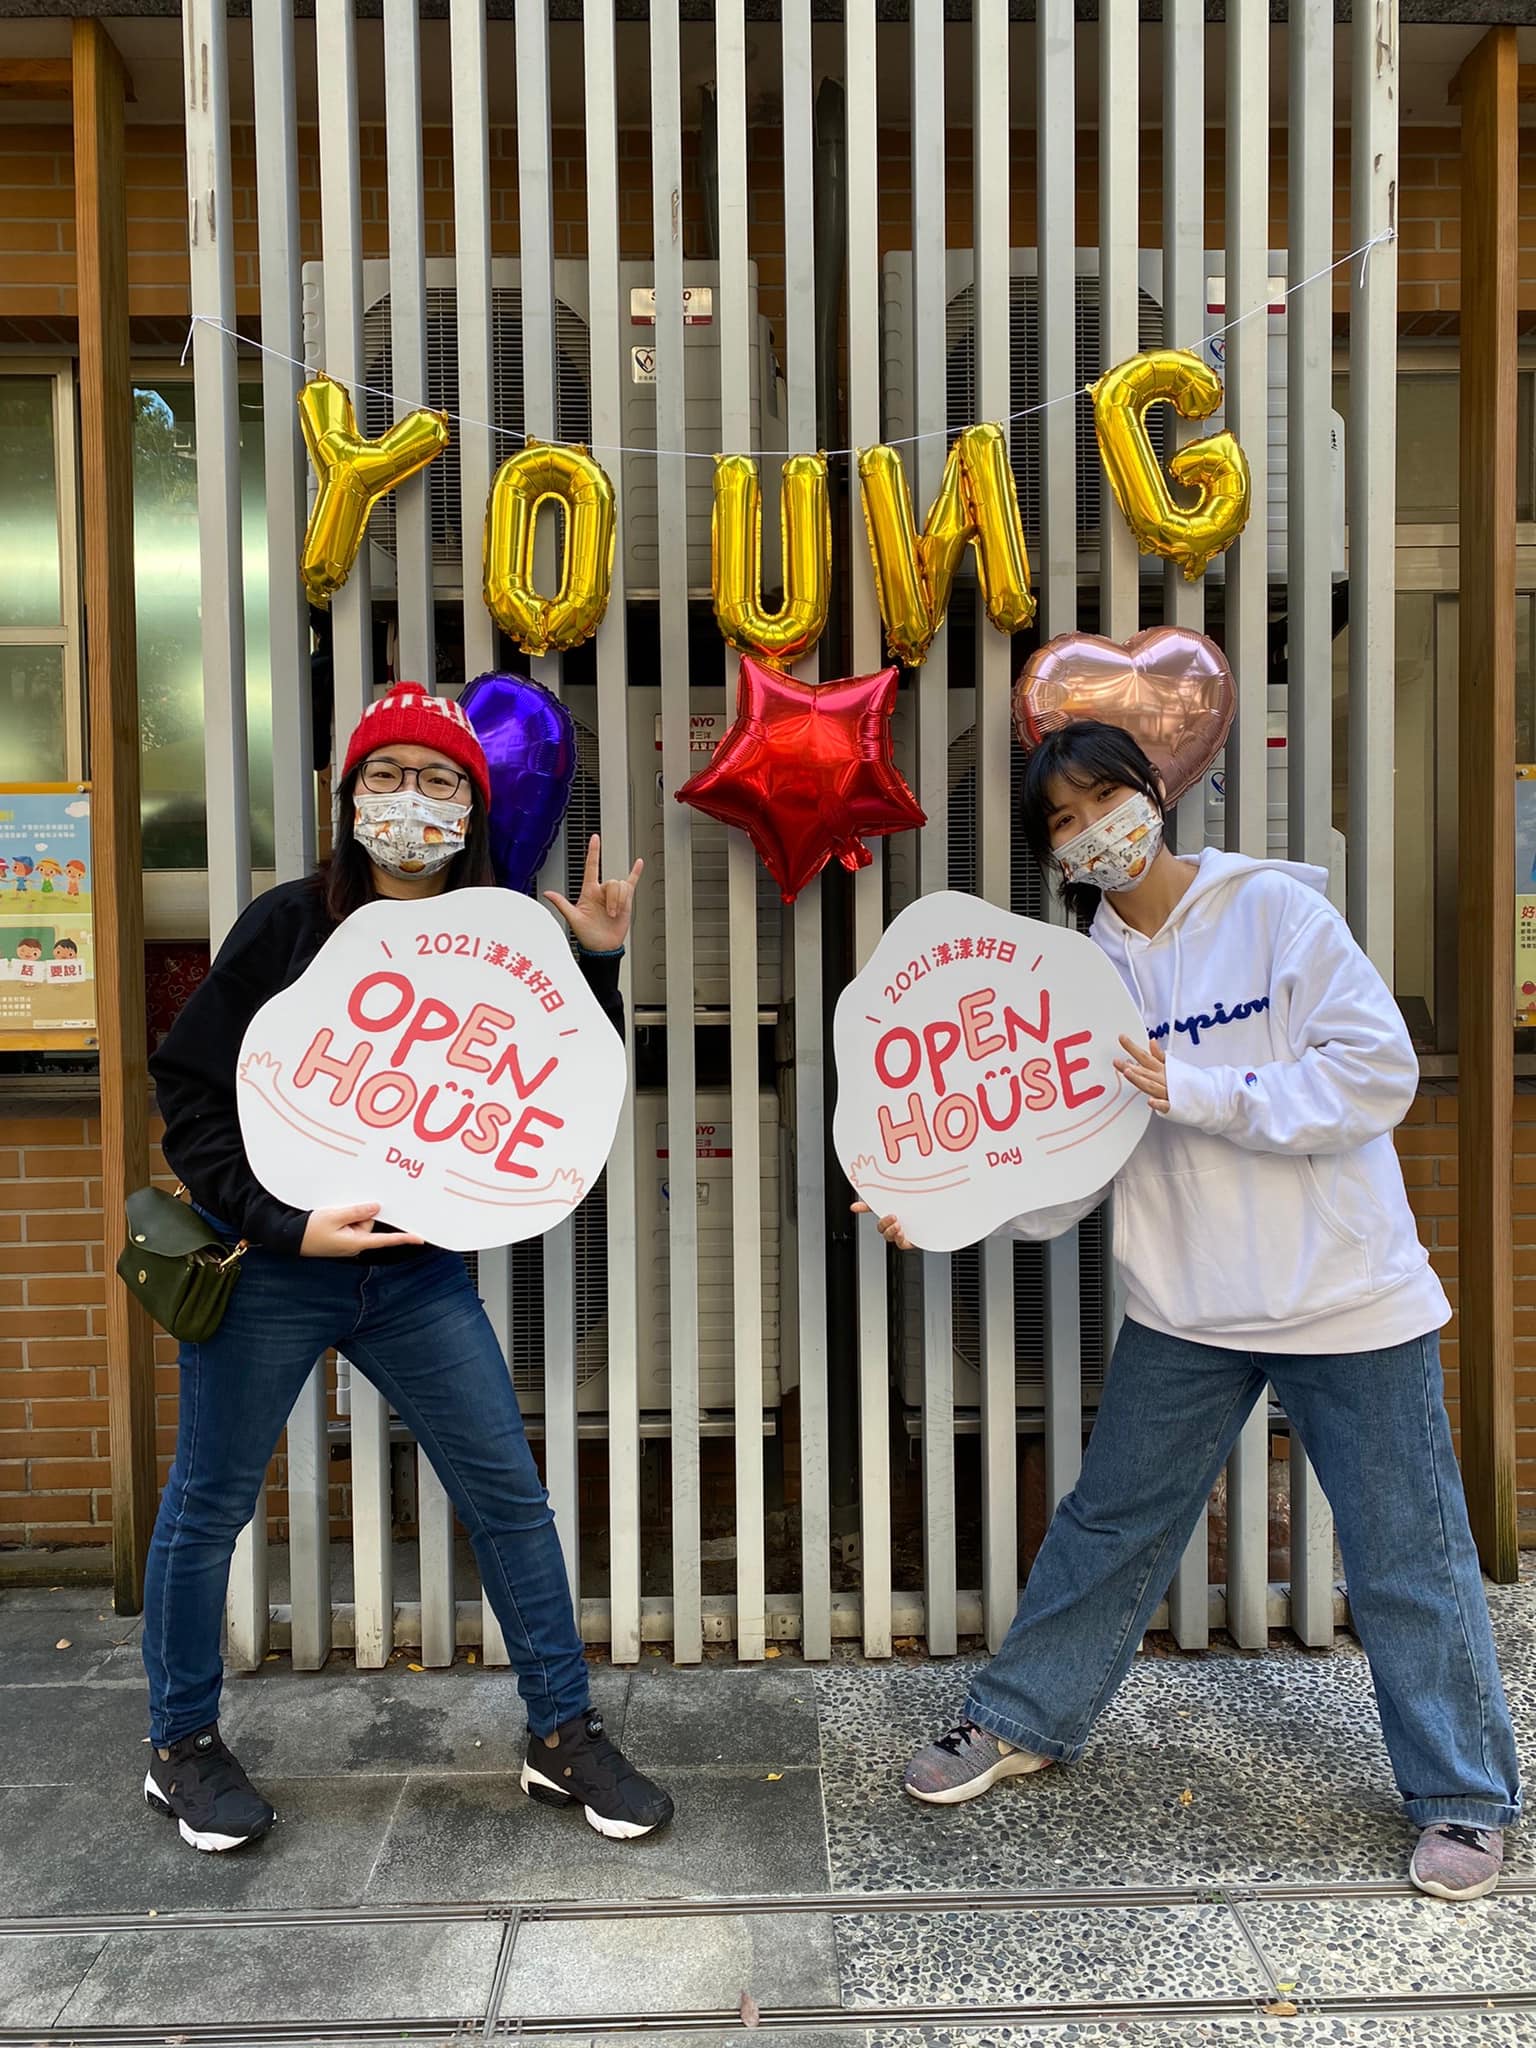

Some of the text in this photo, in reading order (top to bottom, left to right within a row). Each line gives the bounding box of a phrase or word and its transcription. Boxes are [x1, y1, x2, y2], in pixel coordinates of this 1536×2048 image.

[690, 717, 715, 727] NYO
[347, 971, 559, 1099] OPEN
[874, 987, 1050, 1096] OPEN
[292, 1027, 565, 1179] HOUSE
[877, 1030, 1106, 1164] HOUSE
[384, 1146, 425, 1179] Day
[985, 1146, 1023, 1168] Day
